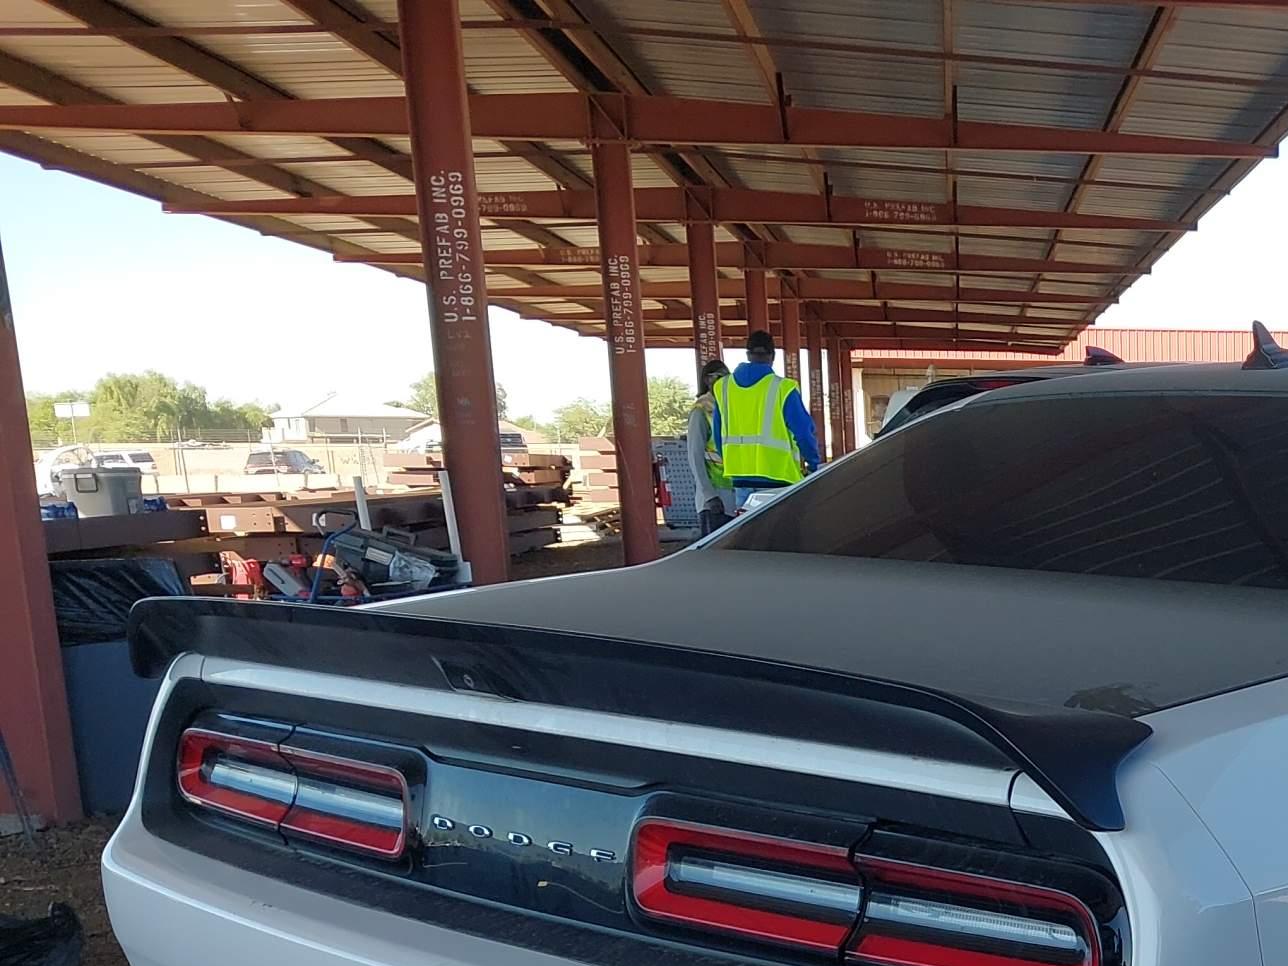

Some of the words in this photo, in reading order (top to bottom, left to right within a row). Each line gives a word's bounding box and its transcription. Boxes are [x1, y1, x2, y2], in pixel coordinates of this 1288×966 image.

[430, 169, 446, 204] INC.
[433, 211, 453, 281] PREFAB
[448, 171, 477, 322] 1-866-799-0969
[607, 254, 619, 278] INC.
[443, 289, 459, 323] U.S.
[610, 282, 623, 327] PREFAB
[614, 332, 626, 354] U.S.
[433, 816, 617, 863] DODGE
